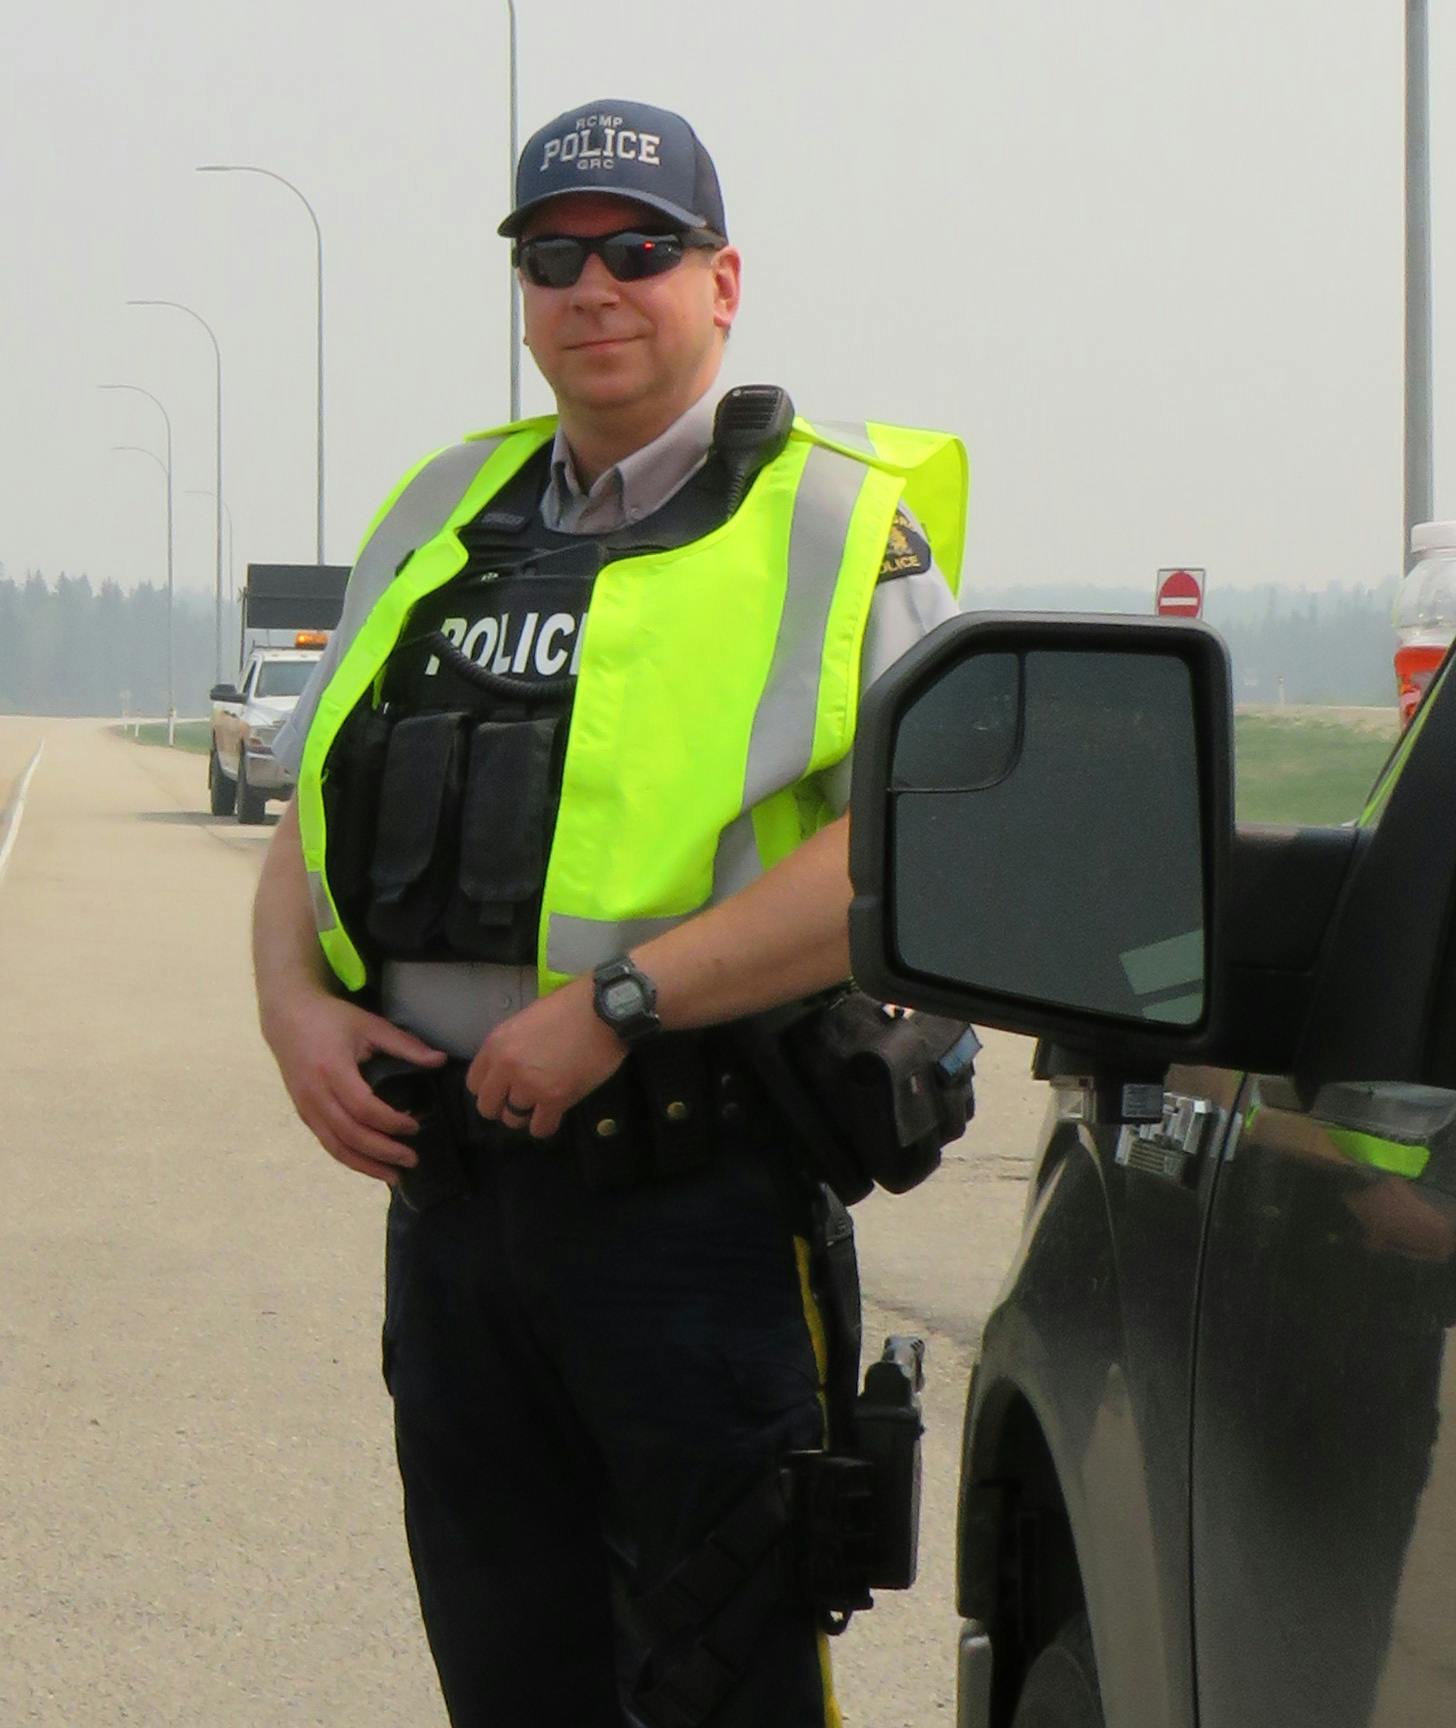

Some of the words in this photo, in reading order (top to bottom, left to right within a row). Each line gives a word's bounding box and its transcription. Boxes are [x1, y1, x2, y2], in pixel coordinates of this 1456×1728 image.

[576, 115, 623, 130] RCMP
[540, 128, 661, 172] POLICE
[577, 158, 615, 170] GRC
[879, 555, 921, 574] OLICE
[424, 612, 588, 676] POLIC
